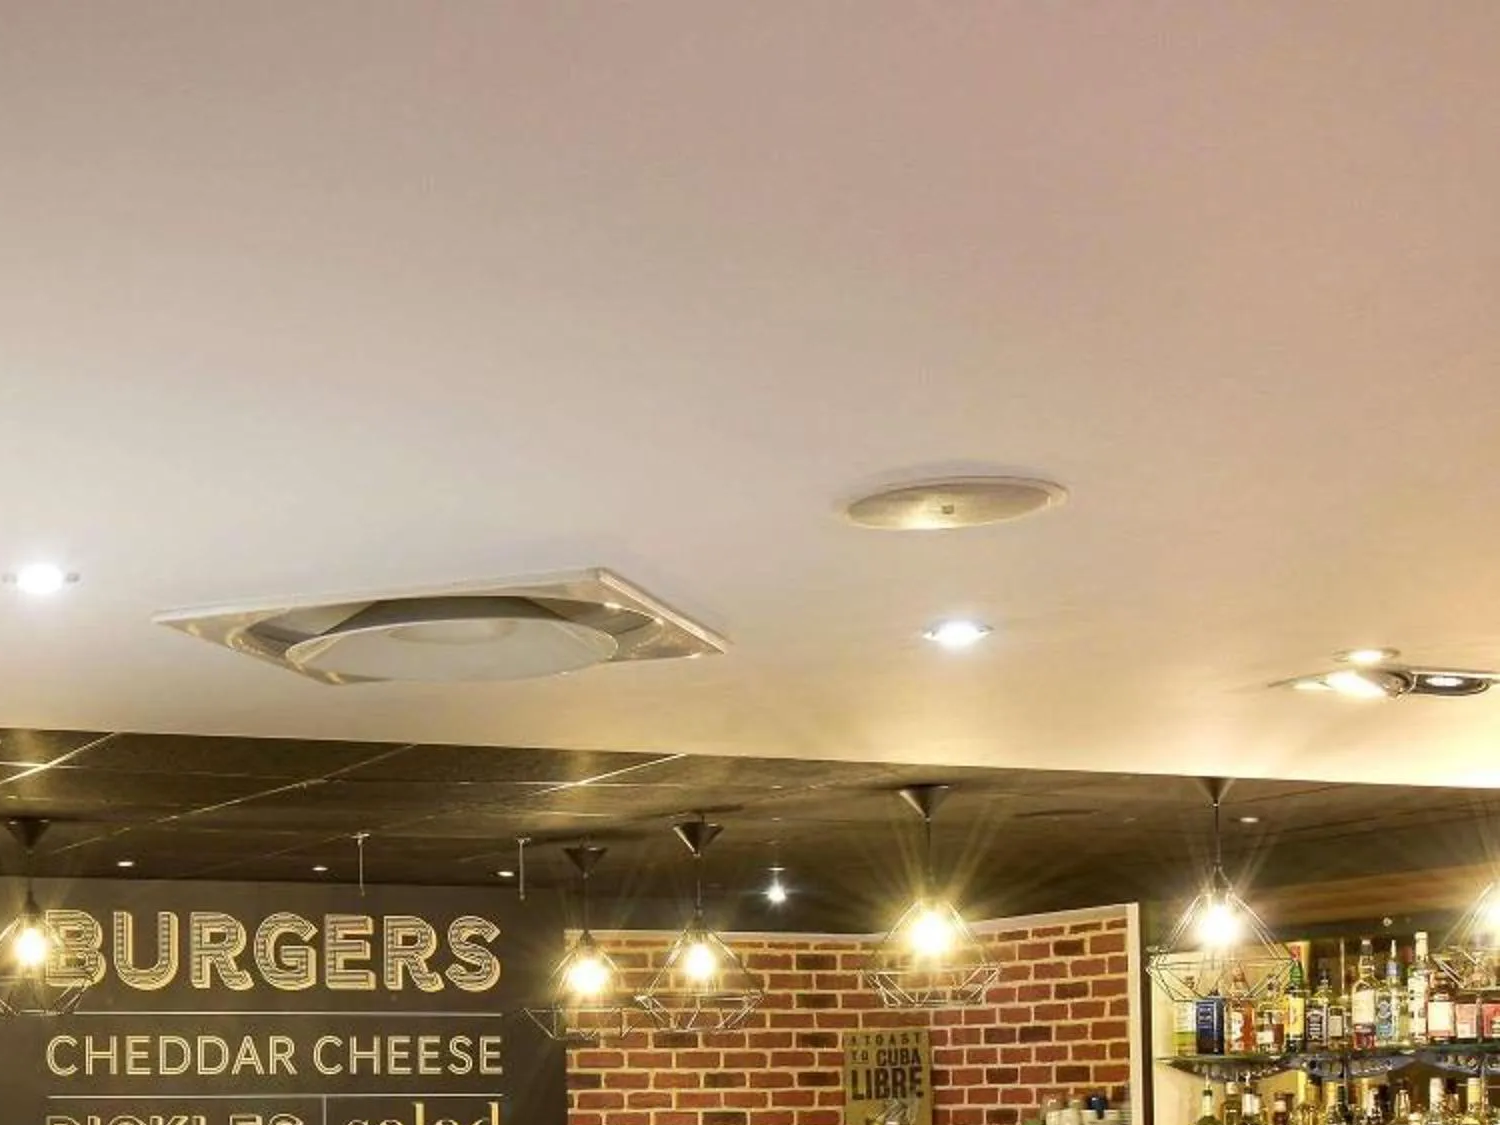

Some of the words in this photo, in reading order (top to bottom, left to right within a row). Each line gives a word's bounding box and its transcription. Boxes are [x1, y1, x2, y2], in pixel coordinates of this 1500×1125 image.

[43, 908, 501, 993] BURGERS
[46, 1035, 297, 1076] CHEDDAR
[313, 1035, 503, 1076] CHEESE
[876, 1047, 921, 1067] CUBA
[851, 1067, 924, 1100] LIBRE
